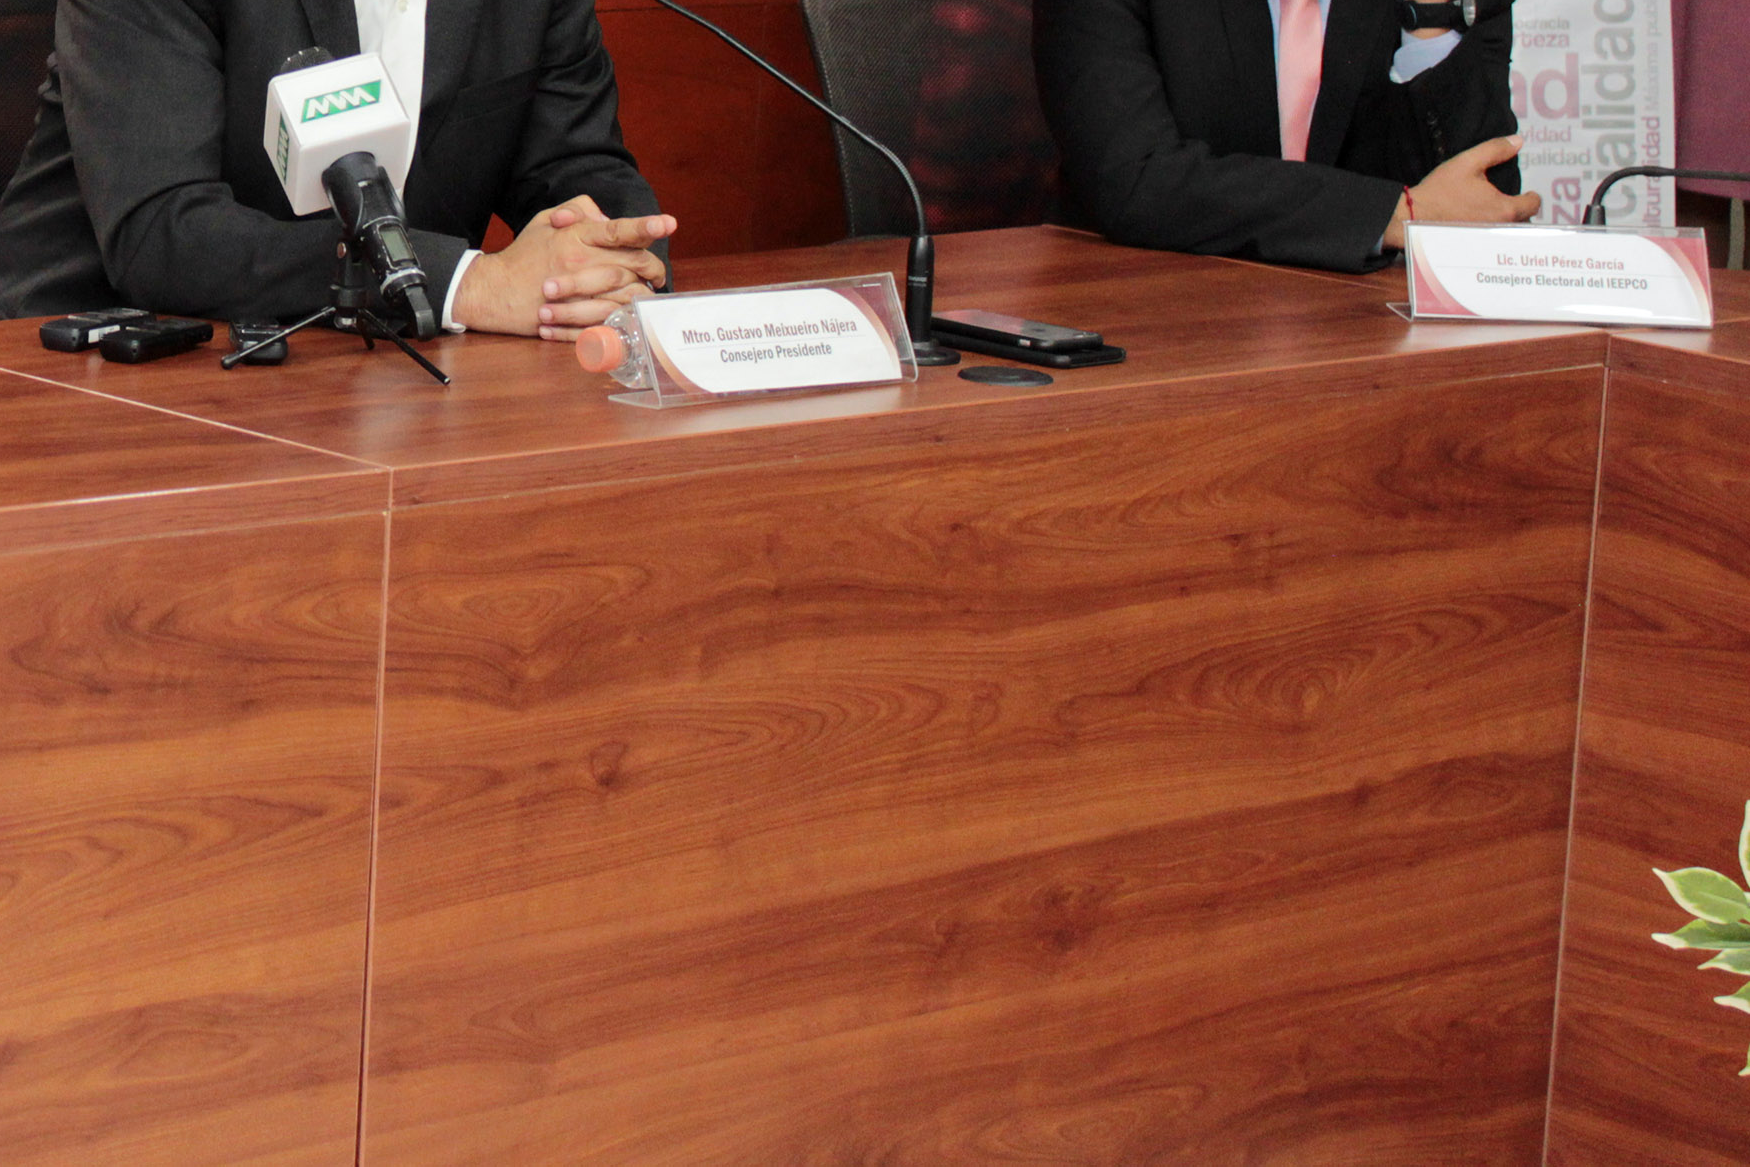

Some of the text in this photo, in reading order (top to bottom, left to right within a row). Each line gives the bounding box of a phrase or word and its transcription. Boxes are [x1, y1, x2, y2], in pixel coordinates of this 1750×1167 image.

[1514, 17, 1570, 31] ocracia
[1512, 32, 1570, 49] rteza
[1518, 148, 1591, 169] galidad
[1496, 253, 1625, 270] Lic. Uriel Pérez García
[1476, 272, 1648, 290] Consejero Electoral del IEEPCO
[682, 318, 858, 344] Mtro. Gustavo Meixueiro Nájera
[720, 342, 832, 364] Consejero Presidente
